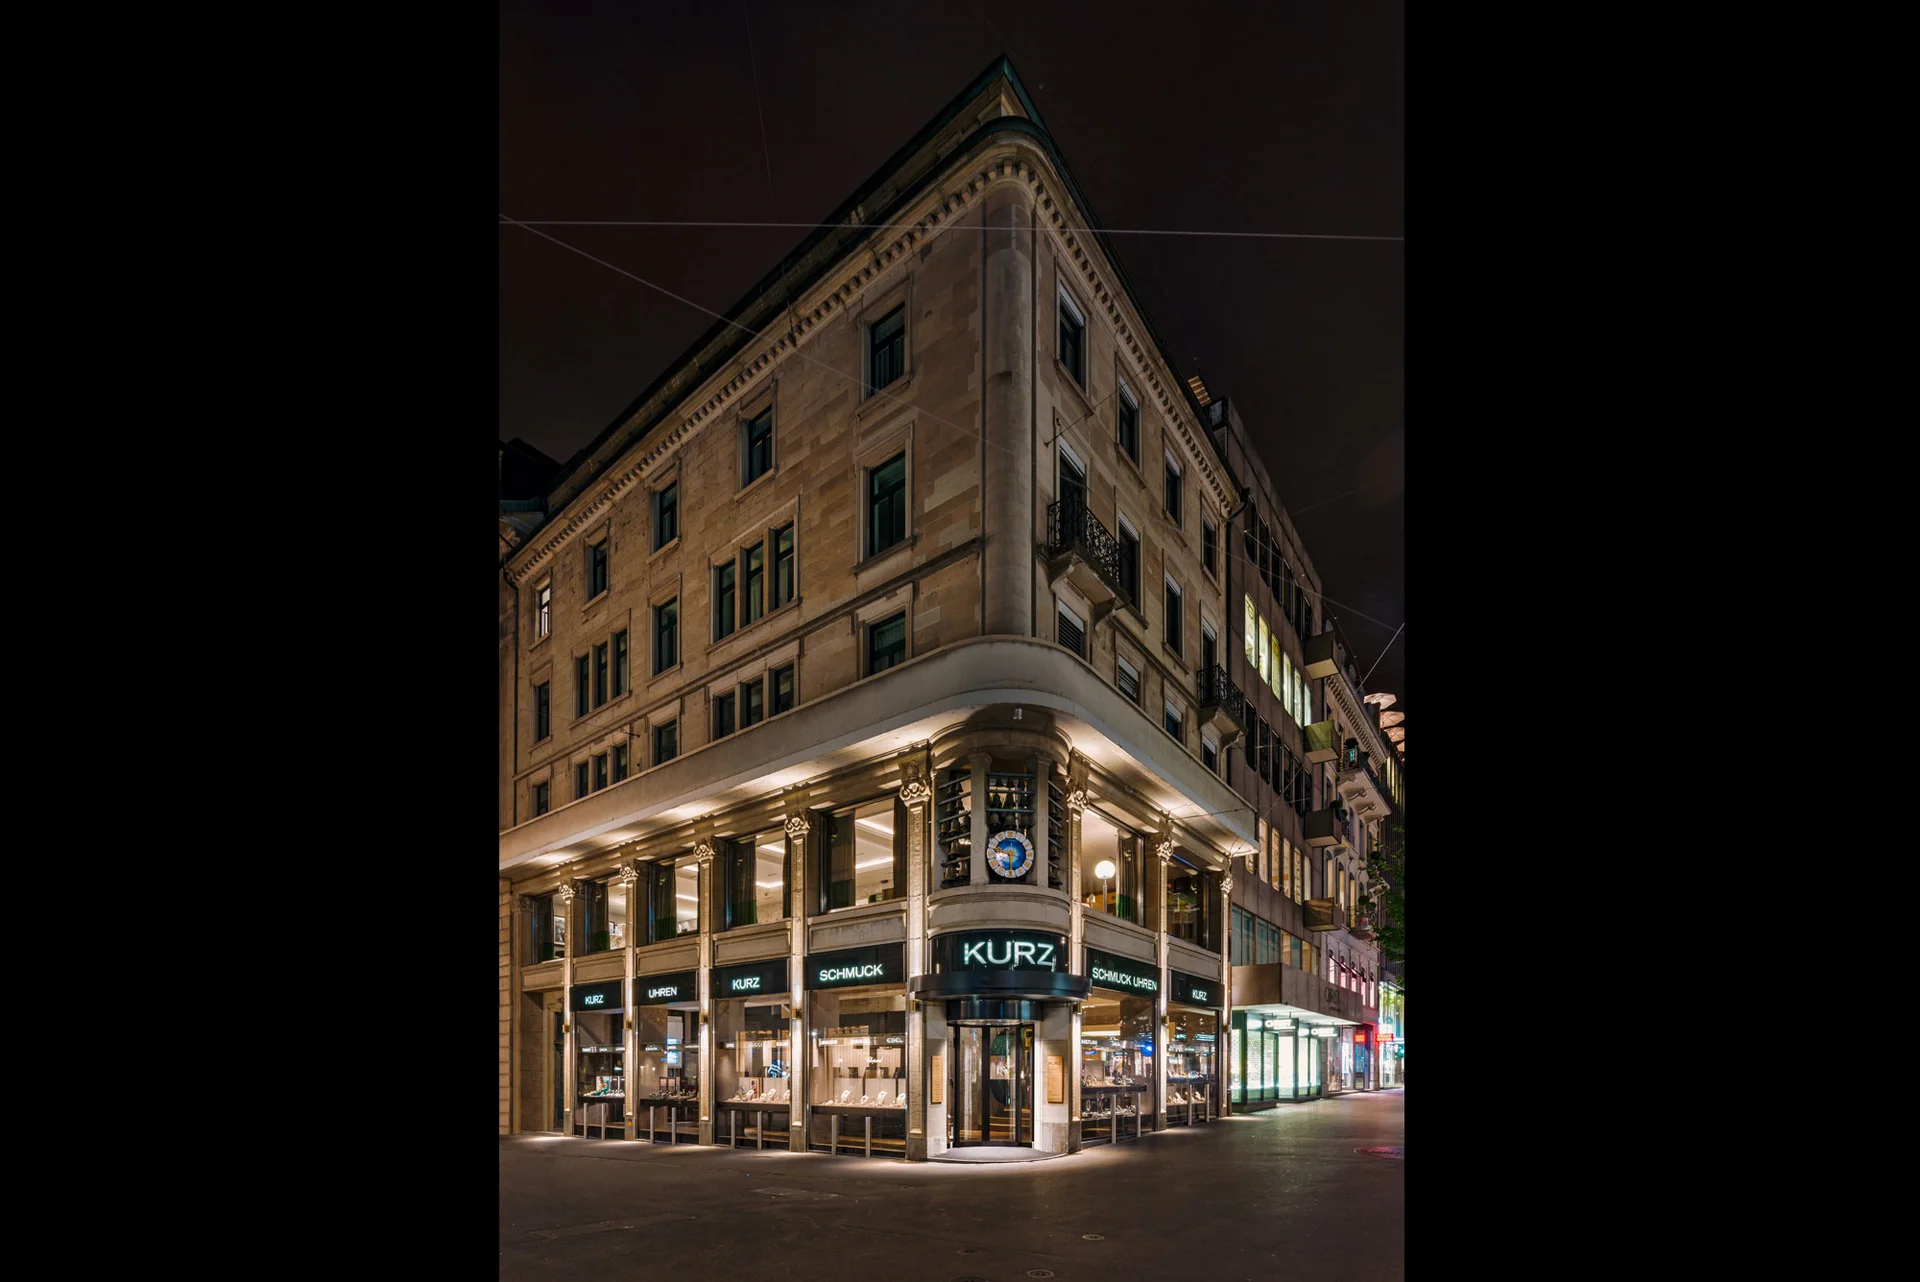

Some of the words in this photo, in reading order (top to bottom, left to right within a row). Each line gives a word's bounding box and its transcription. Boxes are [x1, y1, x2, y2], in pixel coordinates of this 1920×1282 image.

[964, 940, 1055, 966] KURZ
[819, 963, 883, 982] SCHMUCK
[1092, 967, 1132, 986] SCHMUCK
[1133, 976, 1158, 991] UHREN
[732, 977, 760, 991] KURZ
[648, 986, 678, 998] UHREN
[1192, 989, 1208, 1001] KURZ
[584, 994, 604, 1005] KURZ
